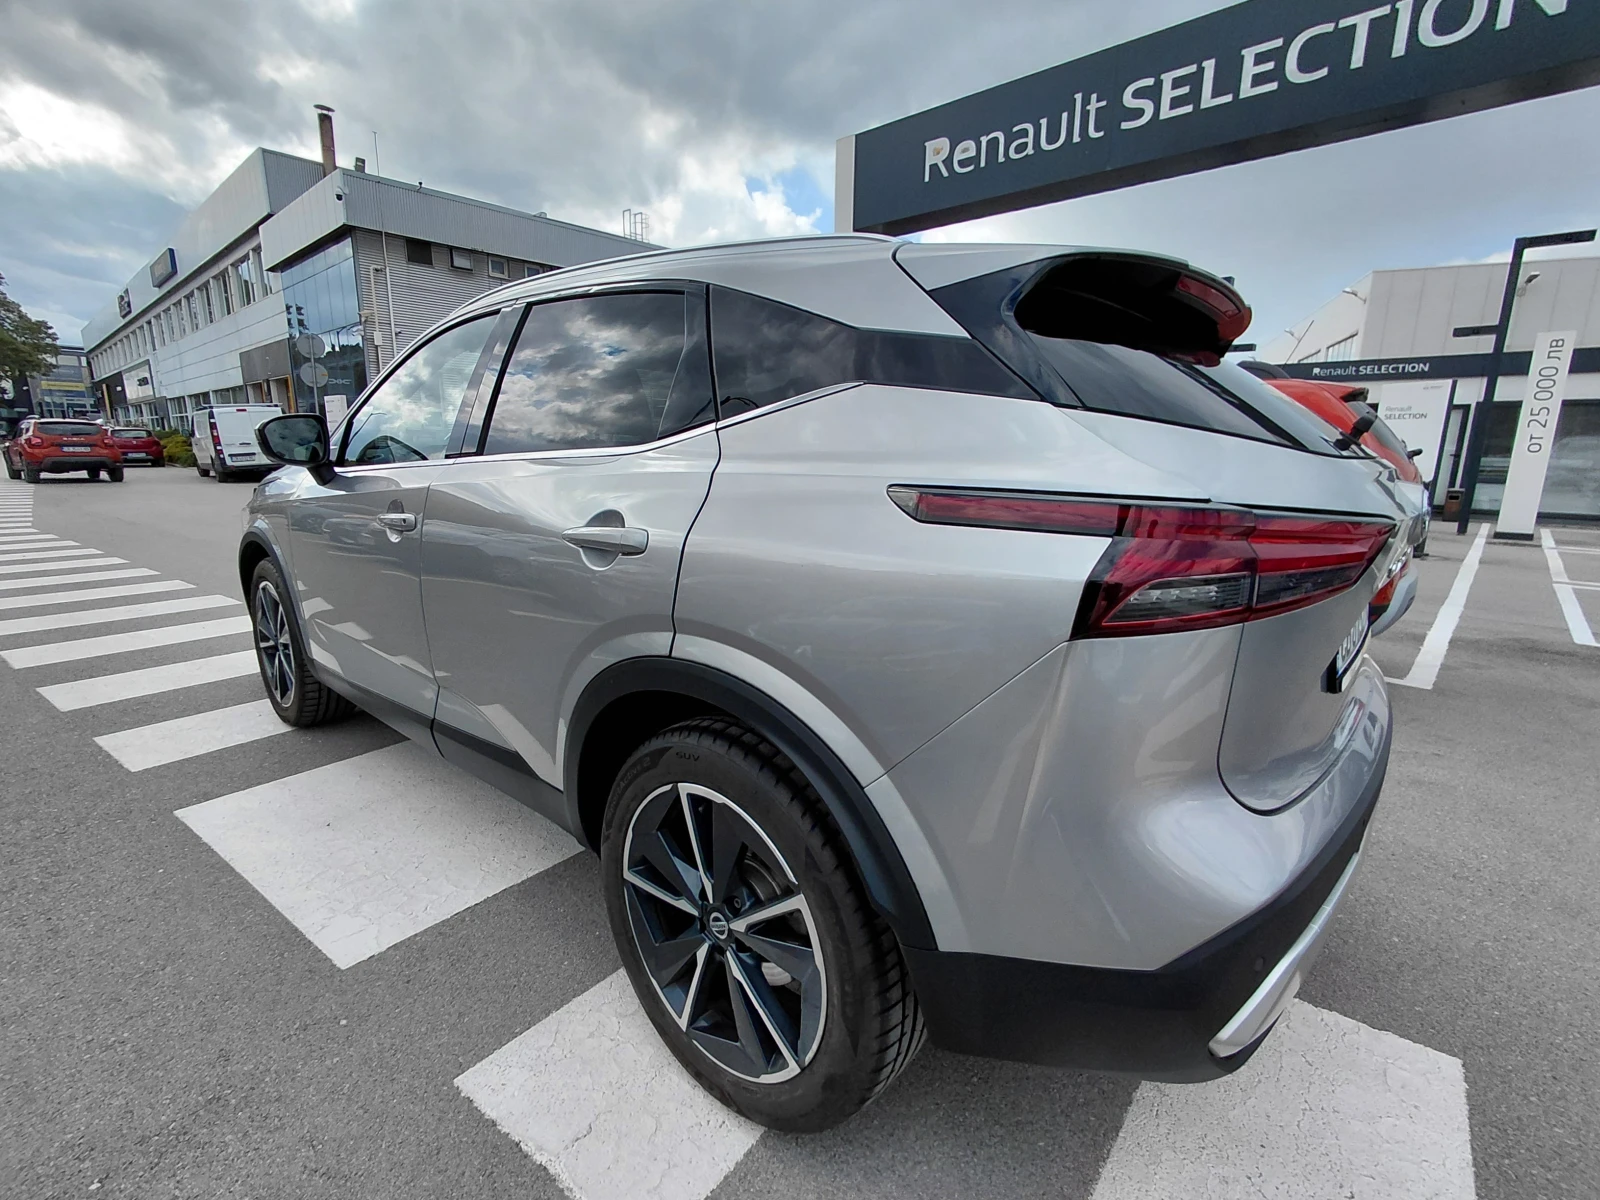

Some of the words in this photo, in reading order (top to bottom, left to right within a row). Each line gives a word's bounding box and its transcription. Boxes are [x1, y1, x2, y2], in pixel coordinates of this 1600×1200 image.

[924, 91, 1107, 182] Renault
[1312, 365, 1357, 377] Renault
[1358, 363, 1430, 375] SELECTION
[1533, 366, 1559, 401] 000
[1385, 405, 1412, 413] Renault
[1384, 412, 1428, 421] SELECTION
[1527, 406, 1550, 429] 25
[675, 751, 700, 762] SUV
